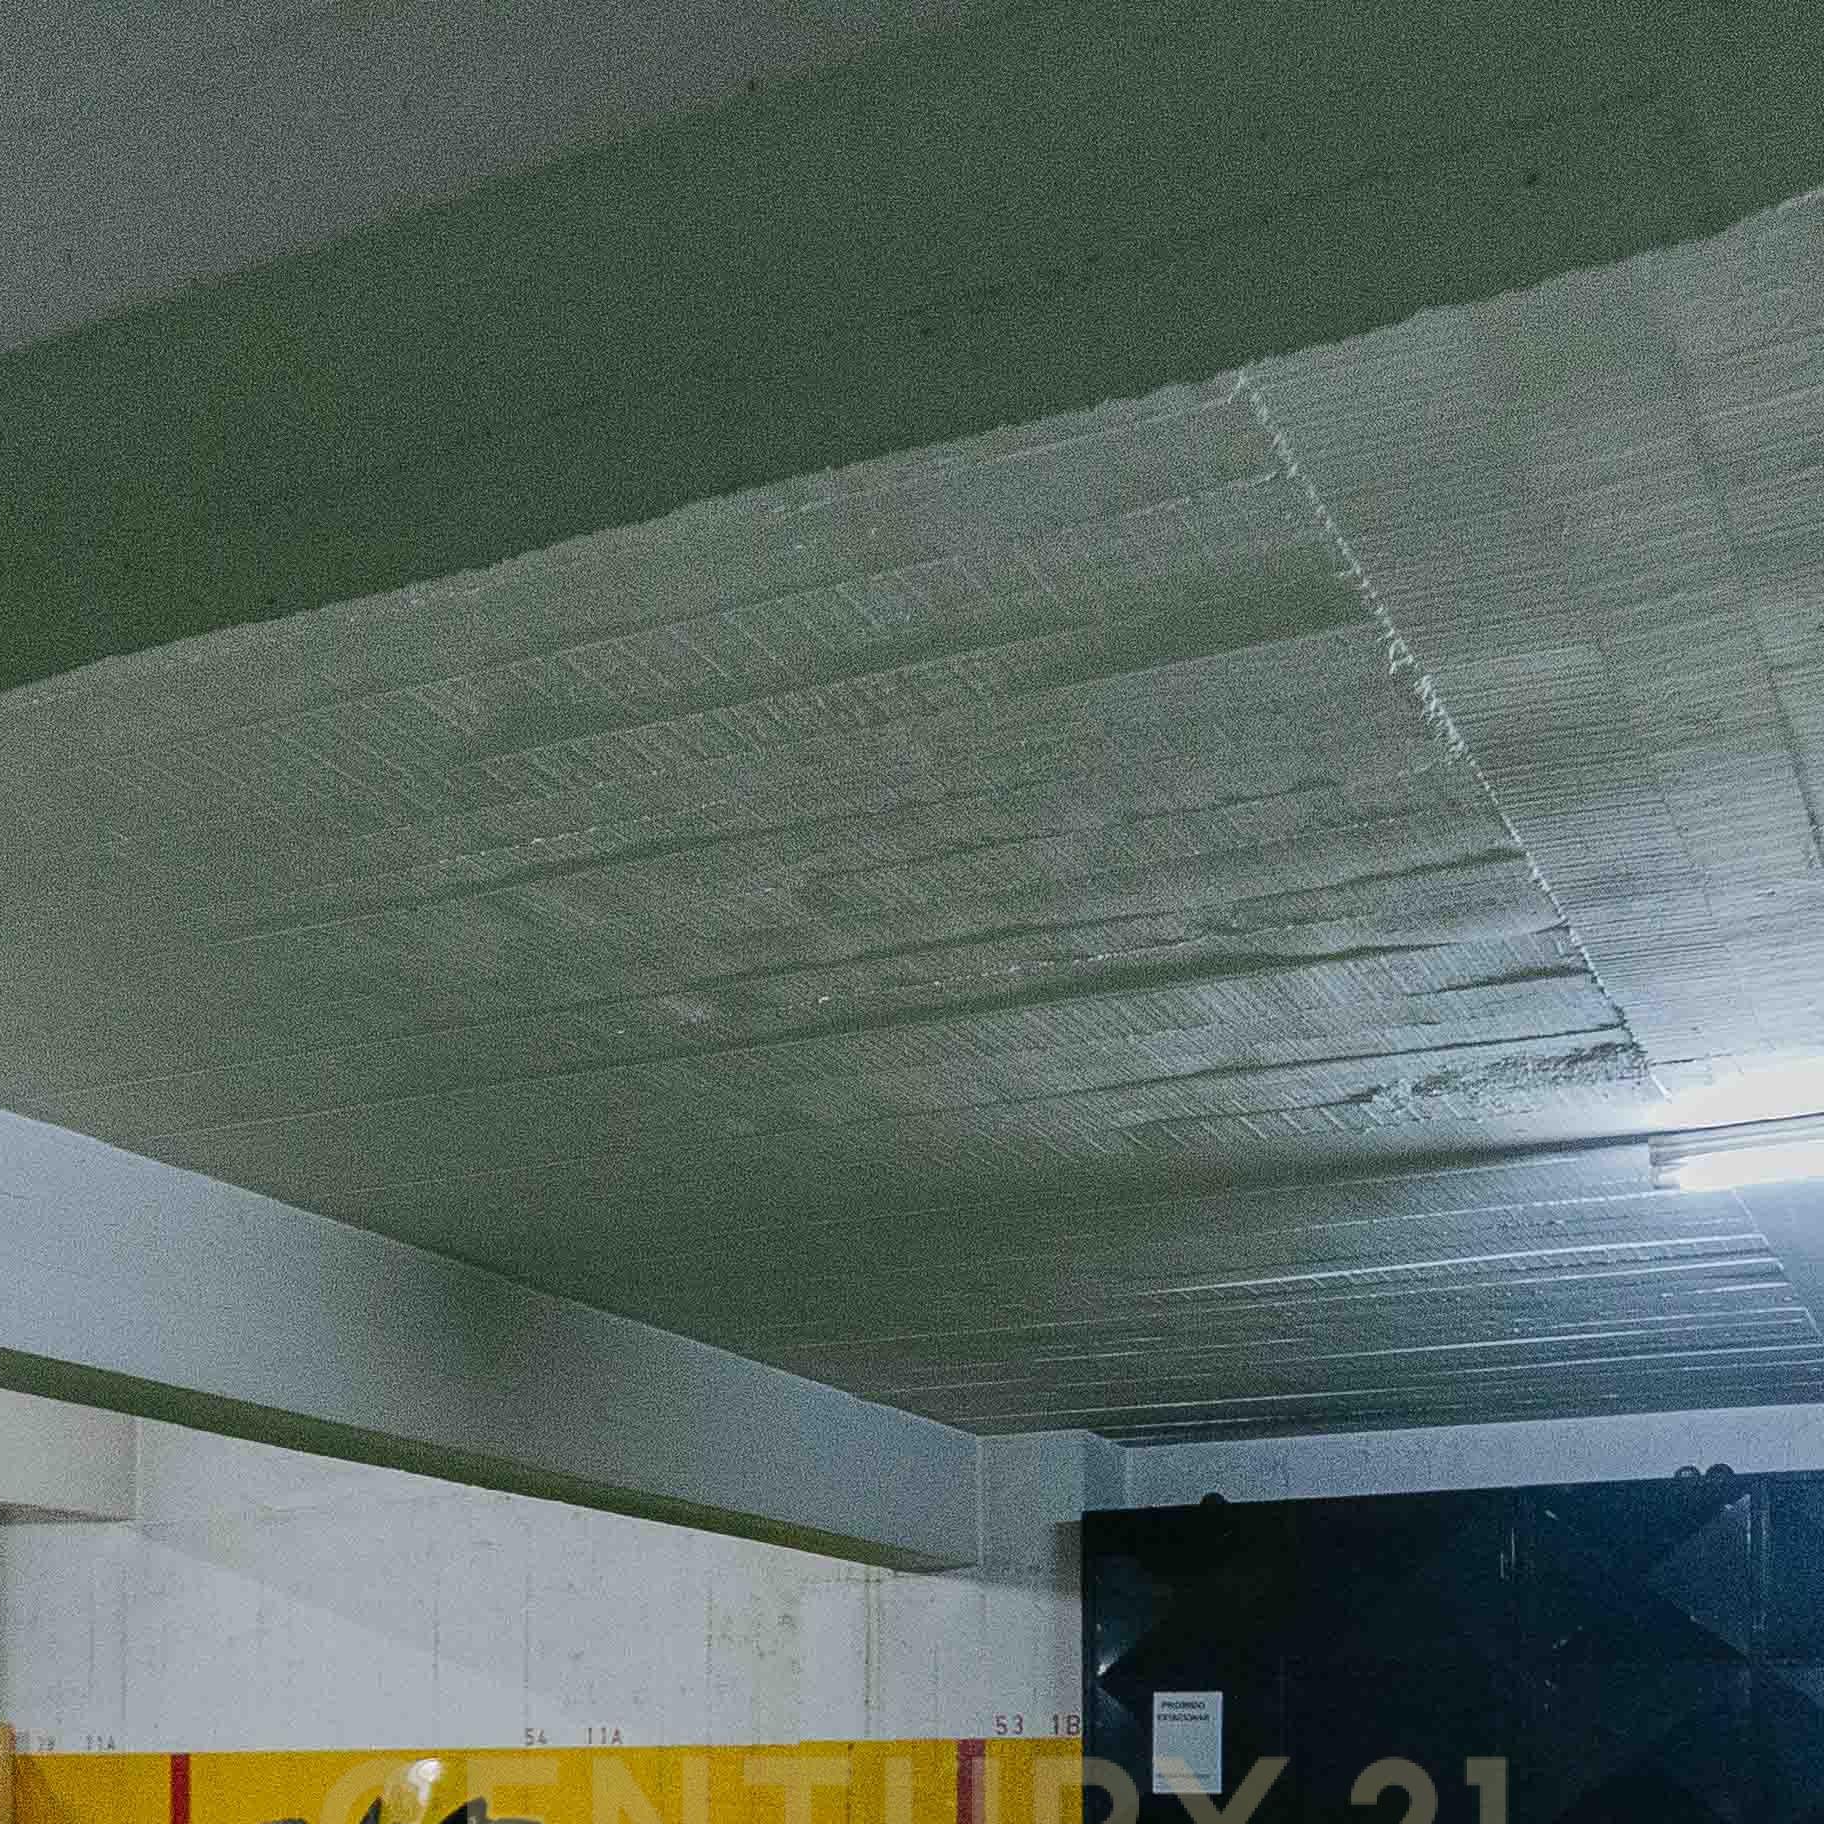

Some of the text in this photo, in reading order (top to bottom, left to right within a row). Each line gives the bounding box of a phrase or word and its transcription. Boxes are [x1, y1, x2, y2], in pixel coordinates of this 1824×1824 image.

[995, 1713, 1081, 1736] 53 1B
[524, 1727, 548, 1746] 54
